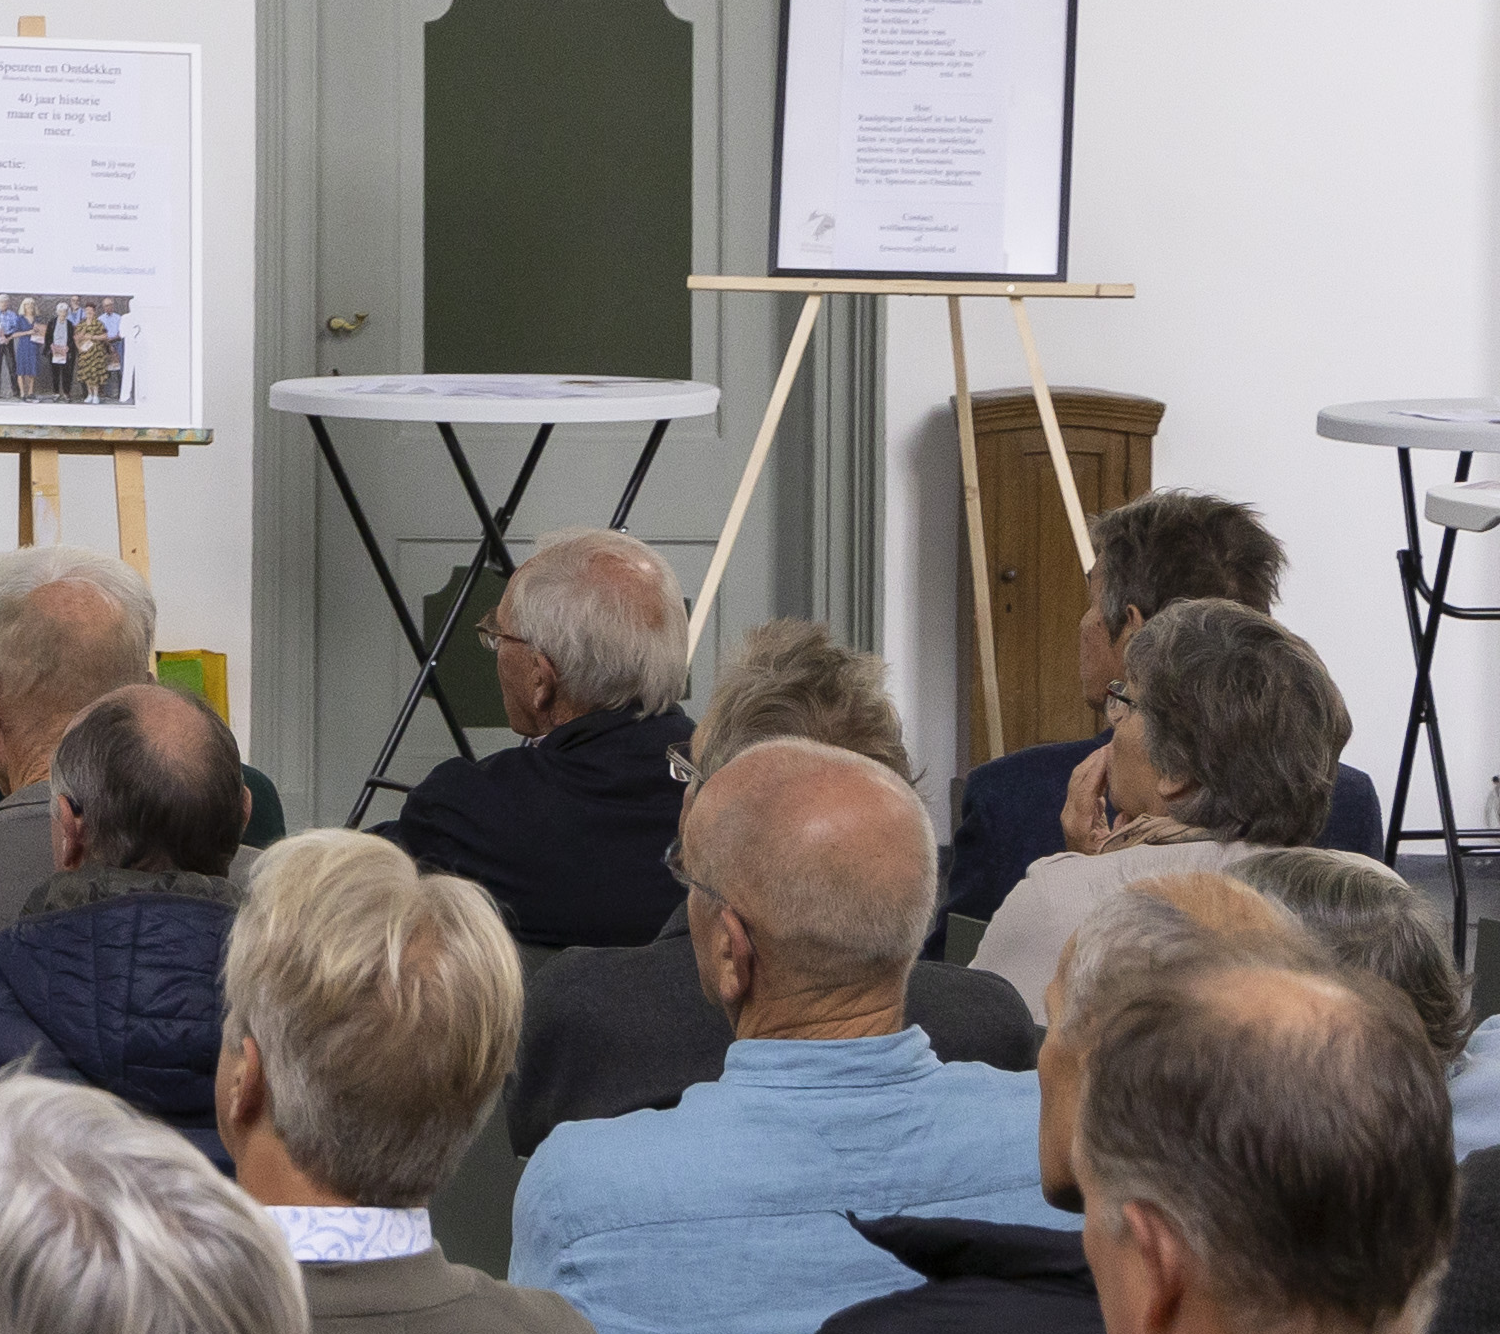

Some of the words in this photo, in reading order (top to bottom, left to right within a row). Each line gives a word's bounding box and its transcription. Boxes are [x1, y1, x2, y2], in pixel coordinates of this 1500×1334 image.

[44, 64, 59, 74] en
[60, 62, 123, 76] Ontdekken
[17, 93, 33, 104] 40
[34, 92, 56, 108] jaar
[58, 93, 101, 107] historie
[6, 110, 35, 121] maar
[37, 111, 50, 121] er
[52, 109, 62, 121] is
[64, 112, 86, 125] nog
[87, 111, 112, 123] veel
